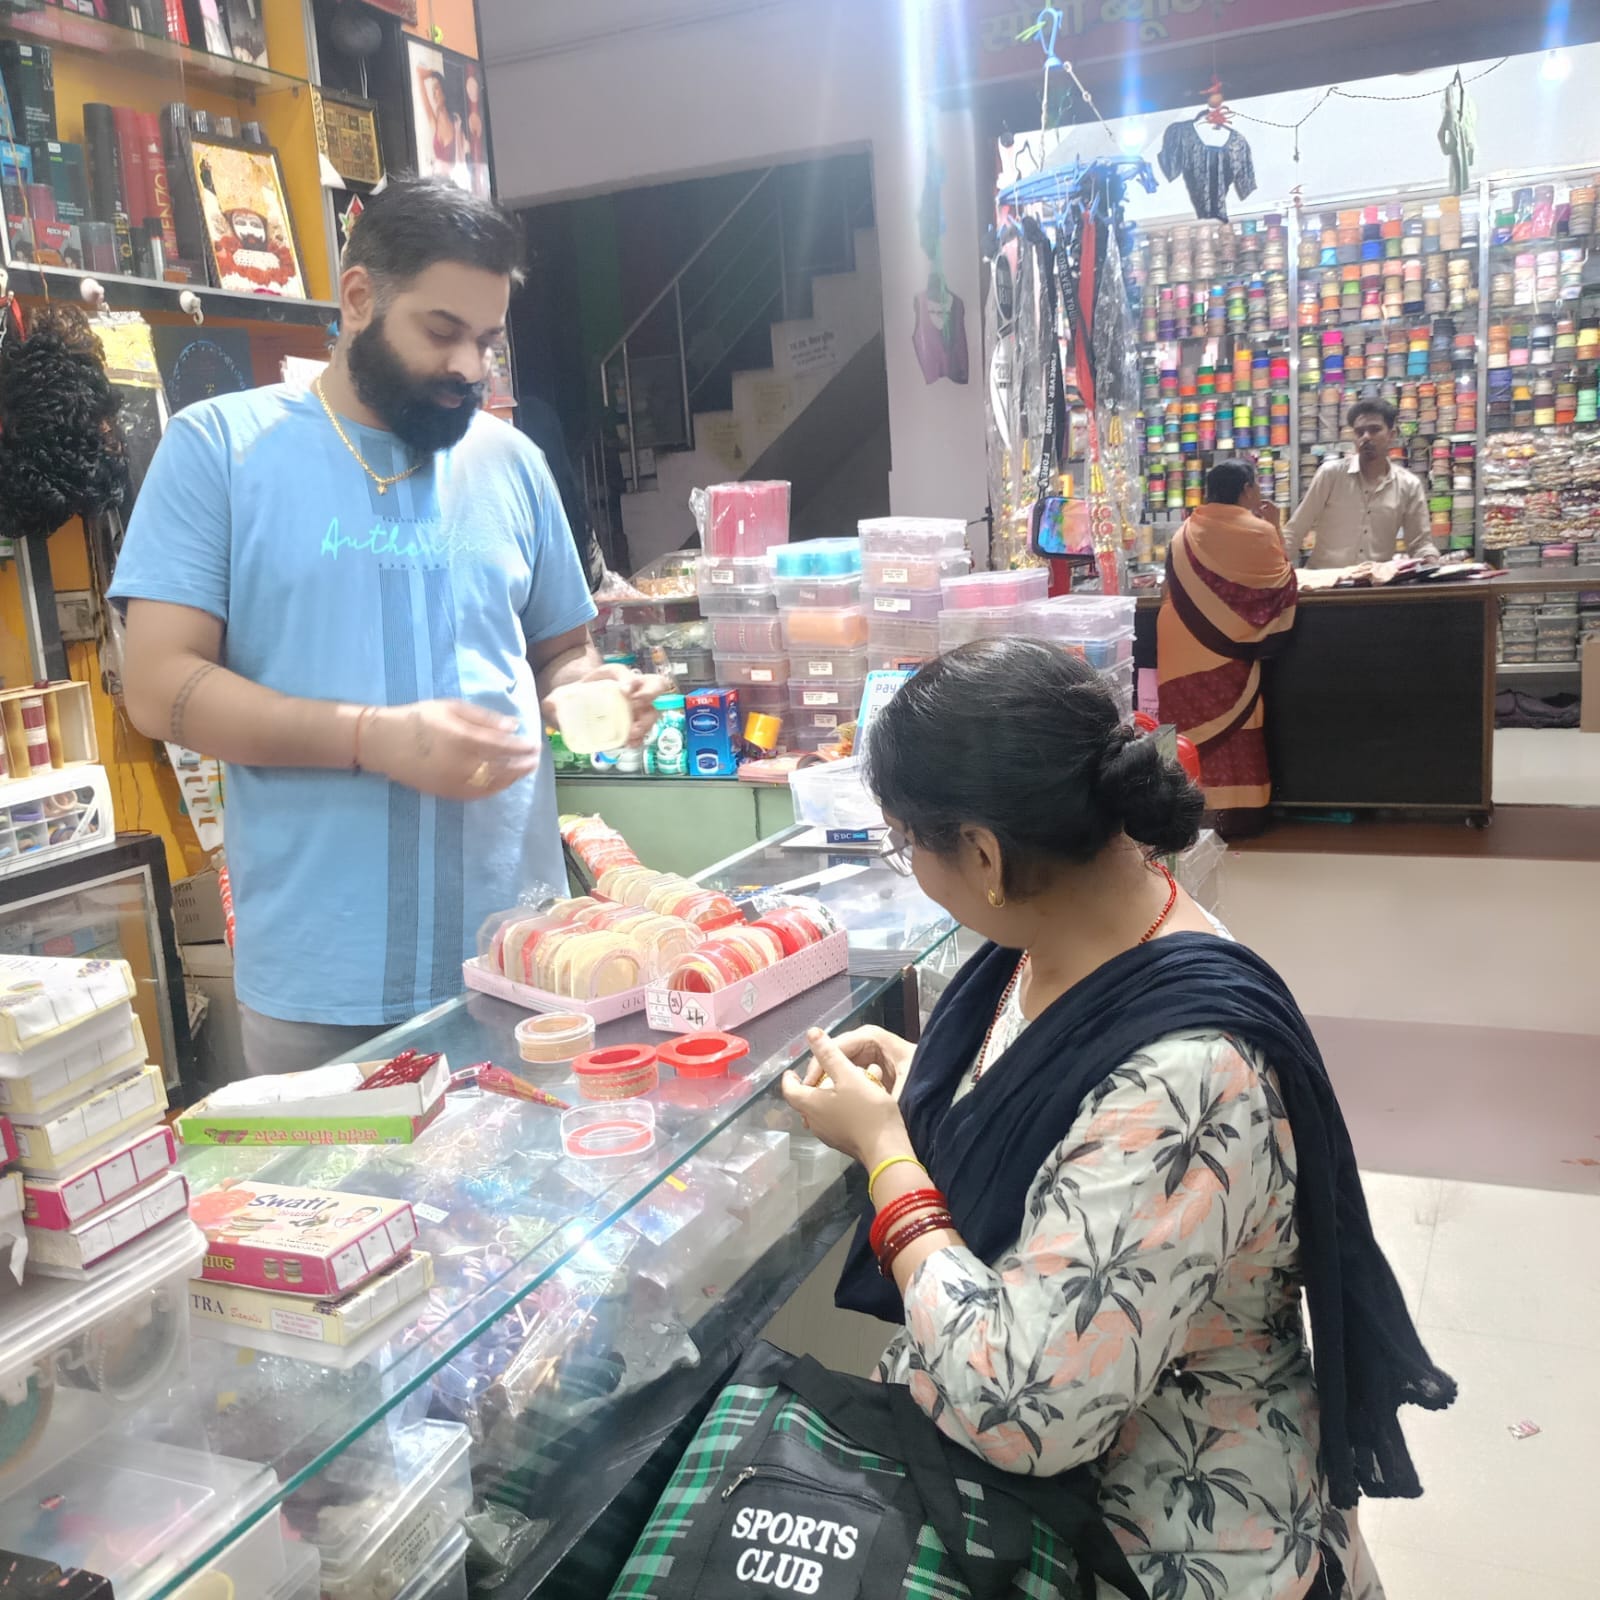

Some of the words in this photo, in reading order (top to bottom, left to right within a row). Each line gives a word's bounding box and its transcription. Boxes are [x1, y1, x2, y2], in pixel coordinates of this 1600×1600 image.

[1048, 352, 1057, 398] FOREVER
[1045, 402, 1054, 435] YOUNG
[248, 1194, 332, 1210] Swati
[731, 1506, 859, 1560] SPORTS
[735, 1547, 824, 1595] CLUB
